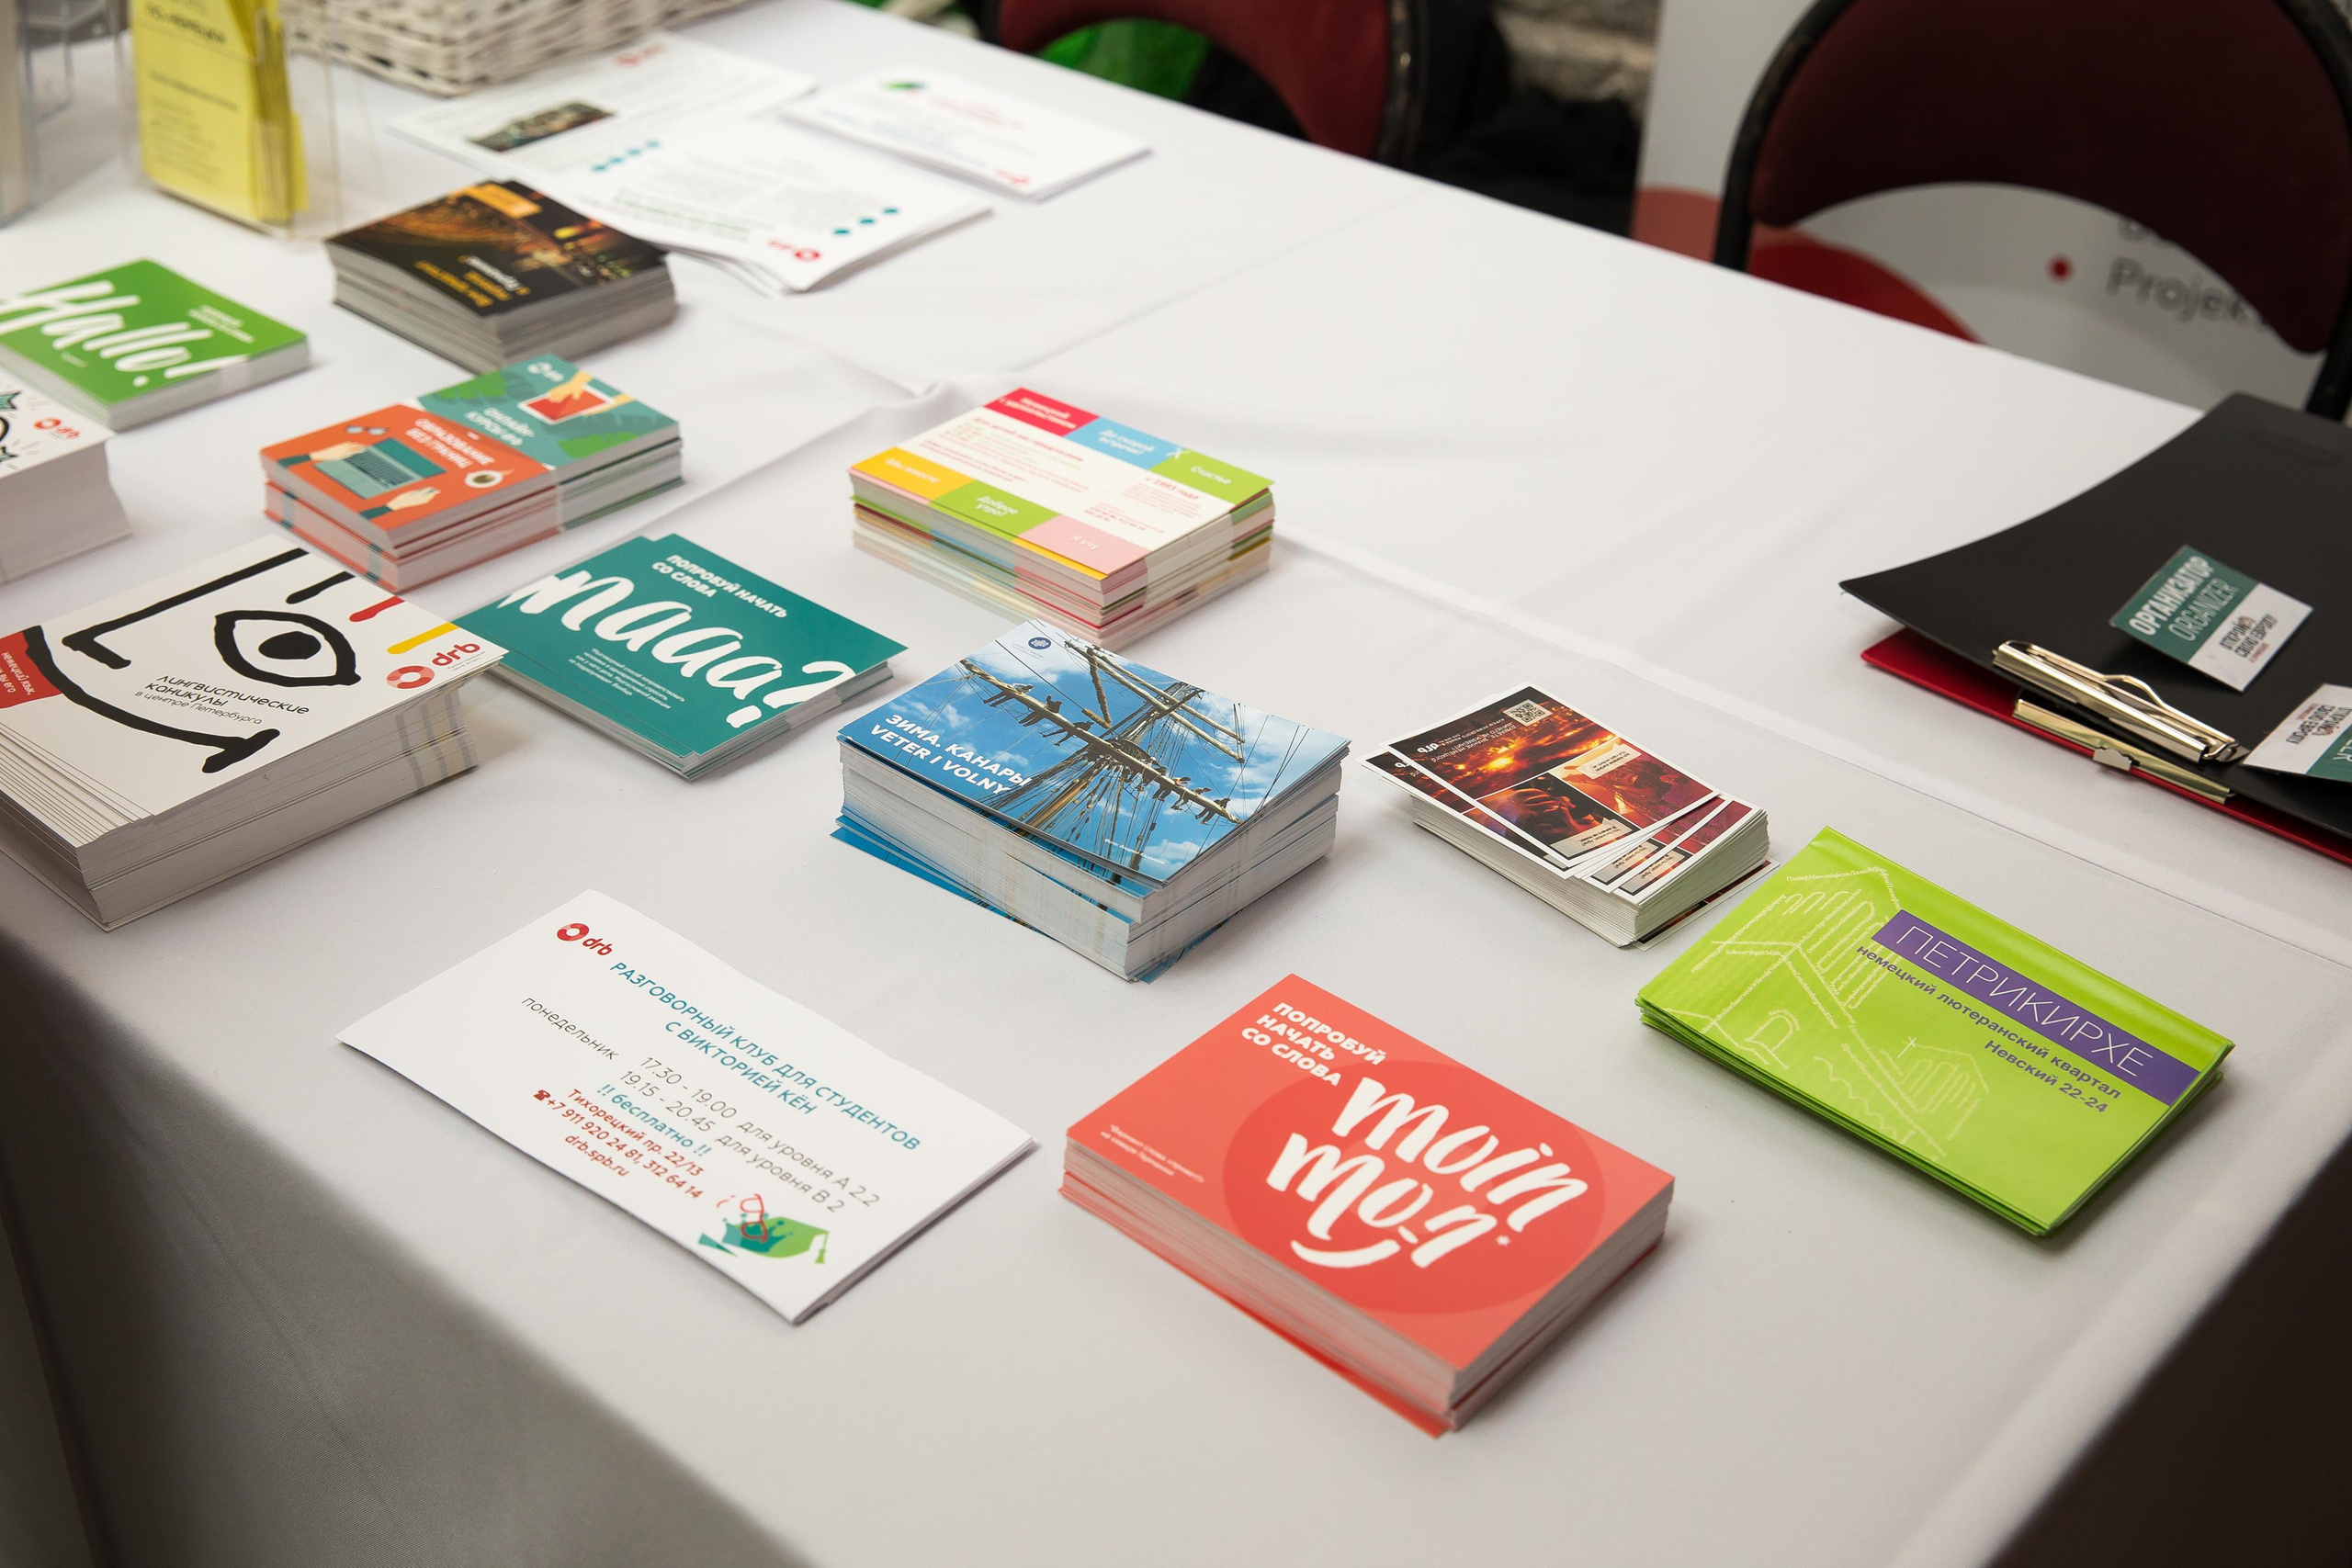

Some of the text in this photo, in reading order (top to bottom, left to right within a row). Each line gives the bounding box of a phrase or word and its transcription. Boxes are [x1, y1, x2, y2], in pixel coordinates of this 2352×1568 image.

[0, 279, 249, 387] Hallo!
[1185, 464, 1237, 485] Счастье
[652, 561, 717, 598] СО СЛОВА
[665, 555, 787, 618] ПОПРОБУЙ НАЧАТЬ
[2129, 556, 2215, 636] ОРГАНИЗАТОР
[2168, 578, 2240, 641] ORGANIZER
[432, 643, 481, 666] drb
[143, 693, 191, 714] центре
[188, 700, 263, 726] Петербурга
[144, 681, 229, 707] каникулы
[869, 725, 933, 763] VETER
[943, 761, 1012, 795] VOLNY
[885, 714, 1032, 790] ЗИМА. КАНАРЫ
[1414, 741, 1441, 754] drb
[582, 938, 613, 956] drb
[522, 998, 619, 1061] понедельник
[1856, 946, 1937, 995] немецкий
[1937, 993, 2050, 1058] лютеранский
[2051, 1056, 2121, 1100] квартал
[1895, 925, 2154, 1077] ПЕТРИКИРХЕ
[609, 962, 921, 1151] РАЗГОВОРНЫЙ КЛУБ ДЛЯ СТУДЕНТОВ
[1241, 1027, 1341, 1087] СО СЛОВА
[1256, 1014, 1336, 1061] НАЧАТЬ
[1272, 1002, 1386, 1066] ПОПРОБУЙ
[664, 1021, 818, 1115] С ВИКТОРИЕЙ КЁН
[1984, 1040, 2109, 1113] Невский 22-24
[568, 1089, 705, 1178] Тихорецкий пр. 22/13
[611, 1093, 694, 1148] бесплатно
[620, 1070, 661, 1099] 19.15
[666, 1100, 716, 1133] 20.45
[716, 1135, 752, 1156] для
[746, 1154, 812, 1195] уровня
[827, 1199, 845, 1213] 2
[640, 1057, 682, 1085] 17.30
[691, 1088, 737, 1119] 19.00
[737, 1122, 773, 1143] для
[768, 1140, 833, 1180] уровня
[849, 1185, 880, 1208] 2.2
[561, 1108, 586, 1124] 911
[581, 1121, 610, 1141] 920
[605, 1137, 628, 1152] 24
[625, 1148, 644, 1165] 81,
[642, 1159, 669, 1179] 312
[665, 1174, 687, 1190] 64
[684, 1185, 705, 1200] 14
[564, 1134, 630, 1178] drb.spb.ru
[1332, 1077, 1589, 1233] moin
